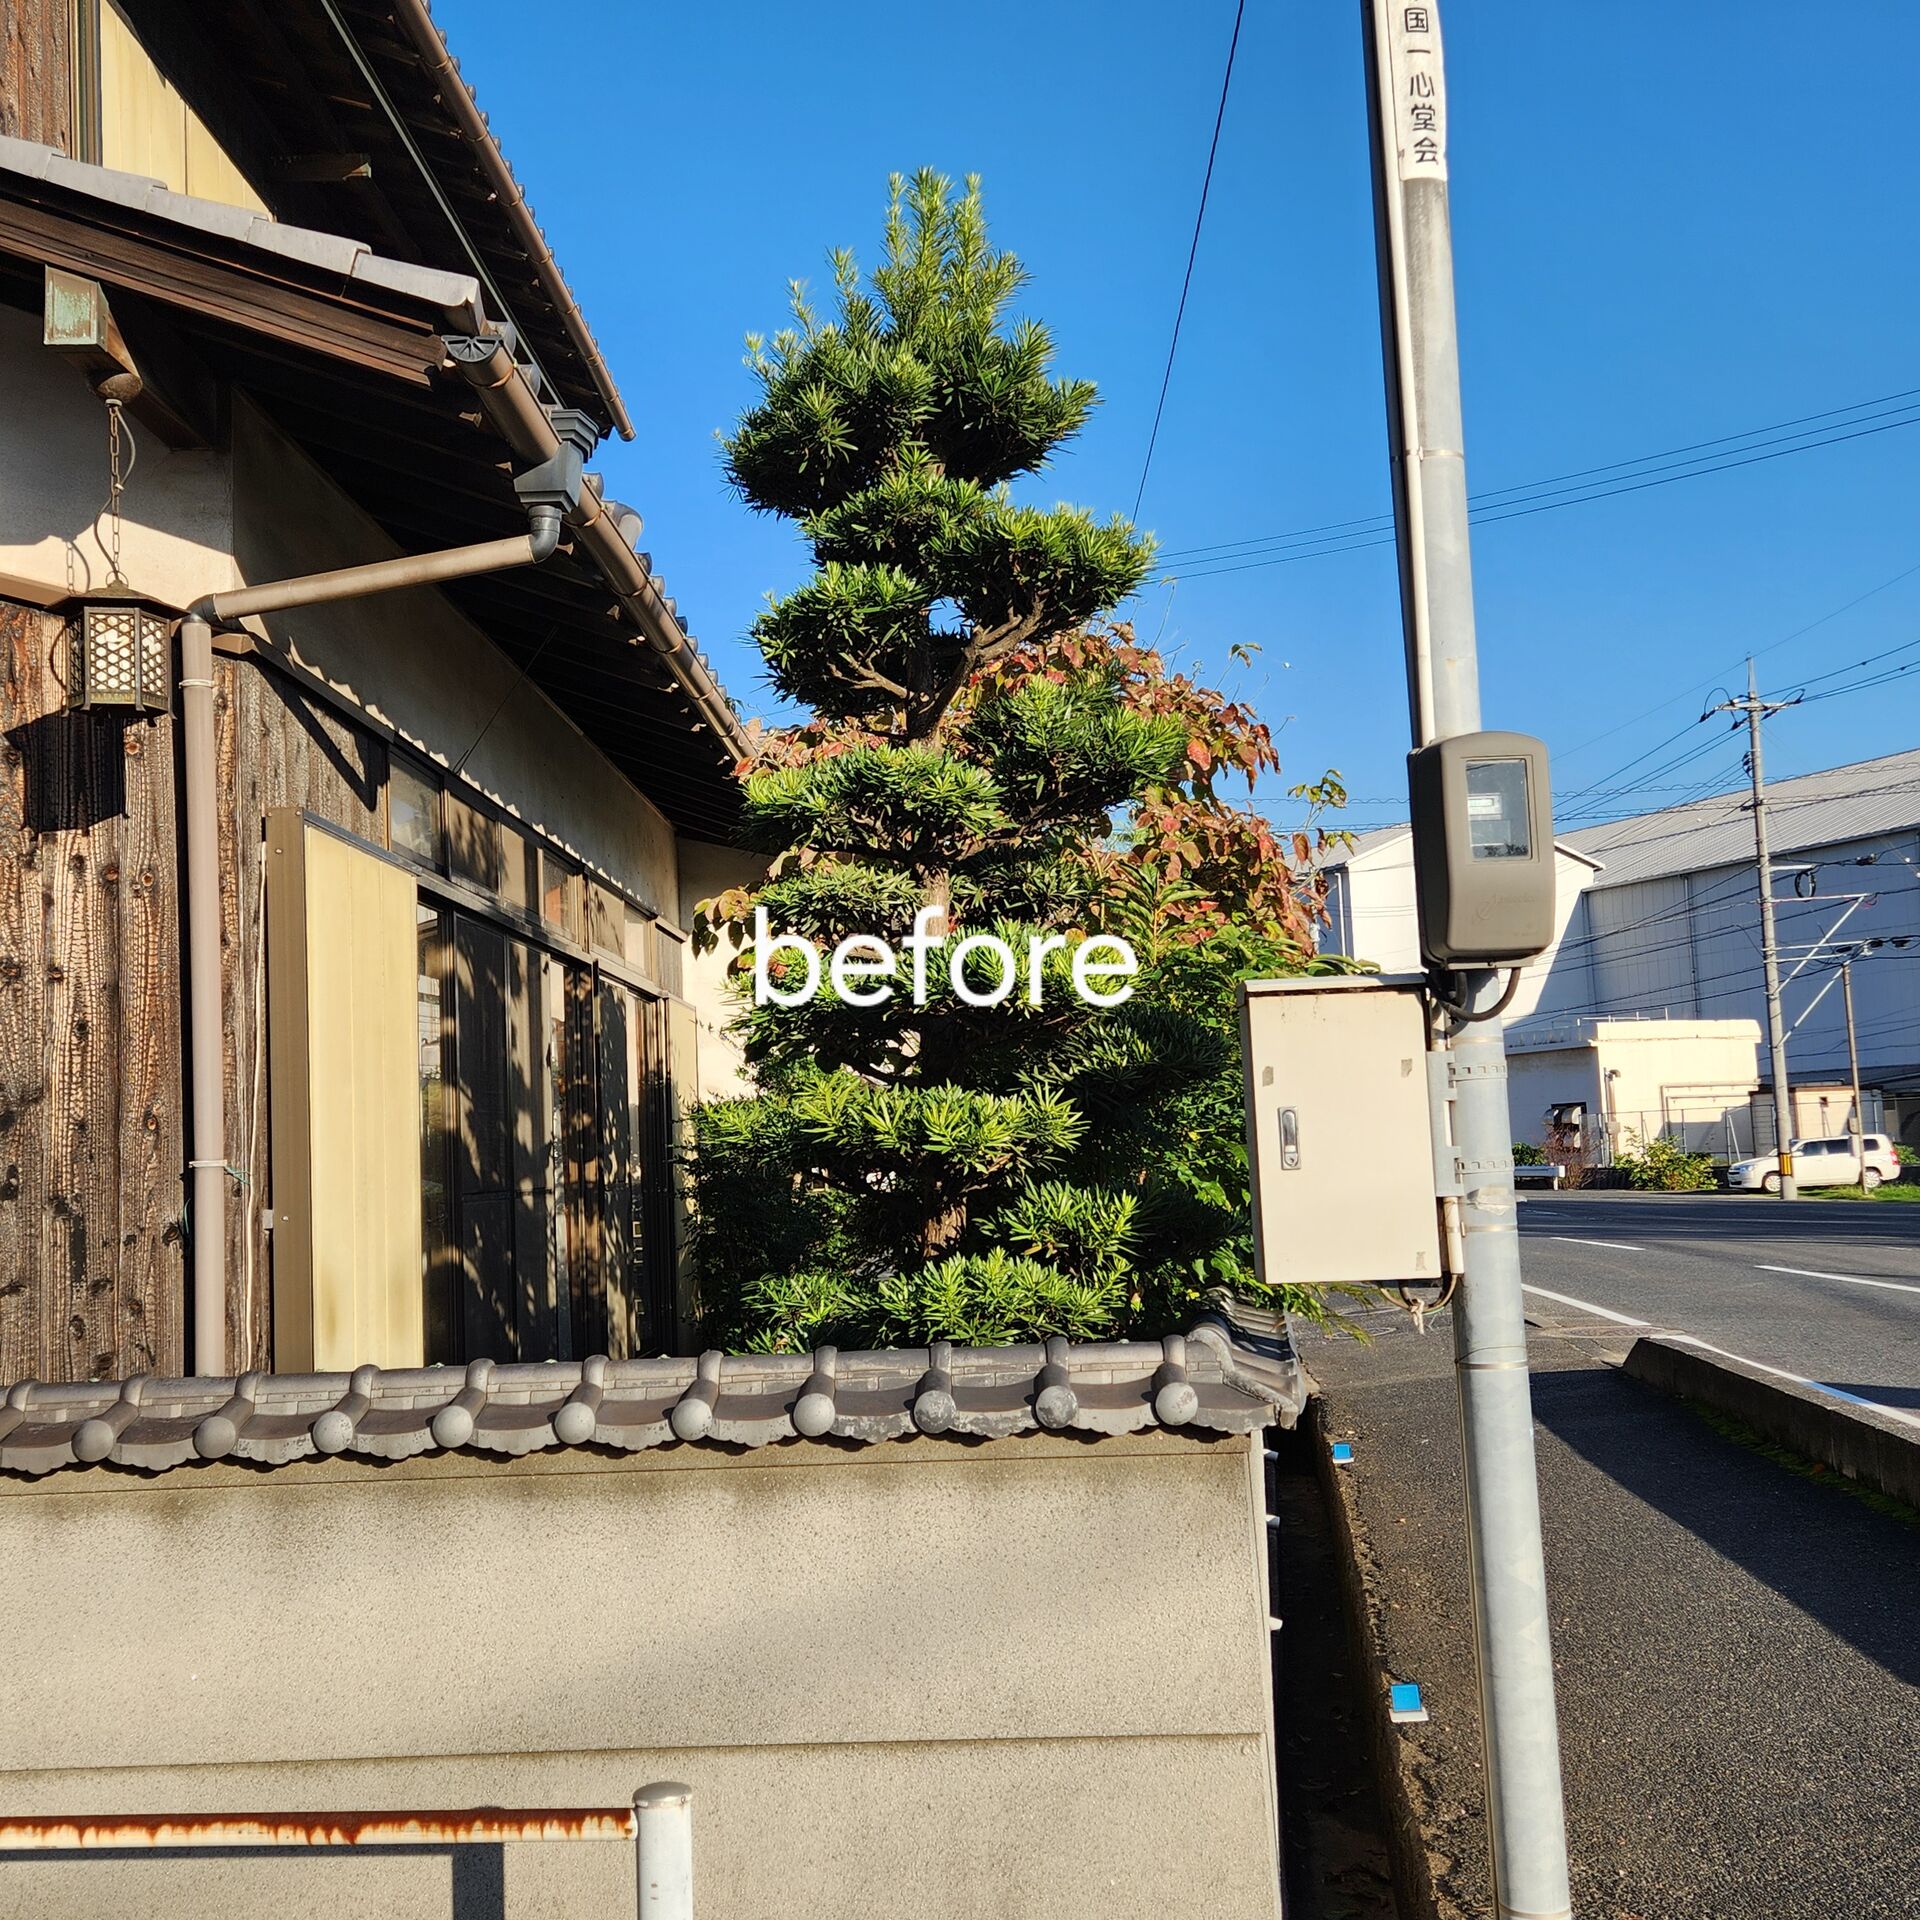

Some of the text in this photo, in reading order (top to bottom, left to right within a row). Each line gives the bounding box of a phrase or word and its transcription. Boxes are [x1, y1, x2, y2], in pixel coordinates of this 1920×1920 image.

[1404, 0, 1440, 165] 国一心堂会
